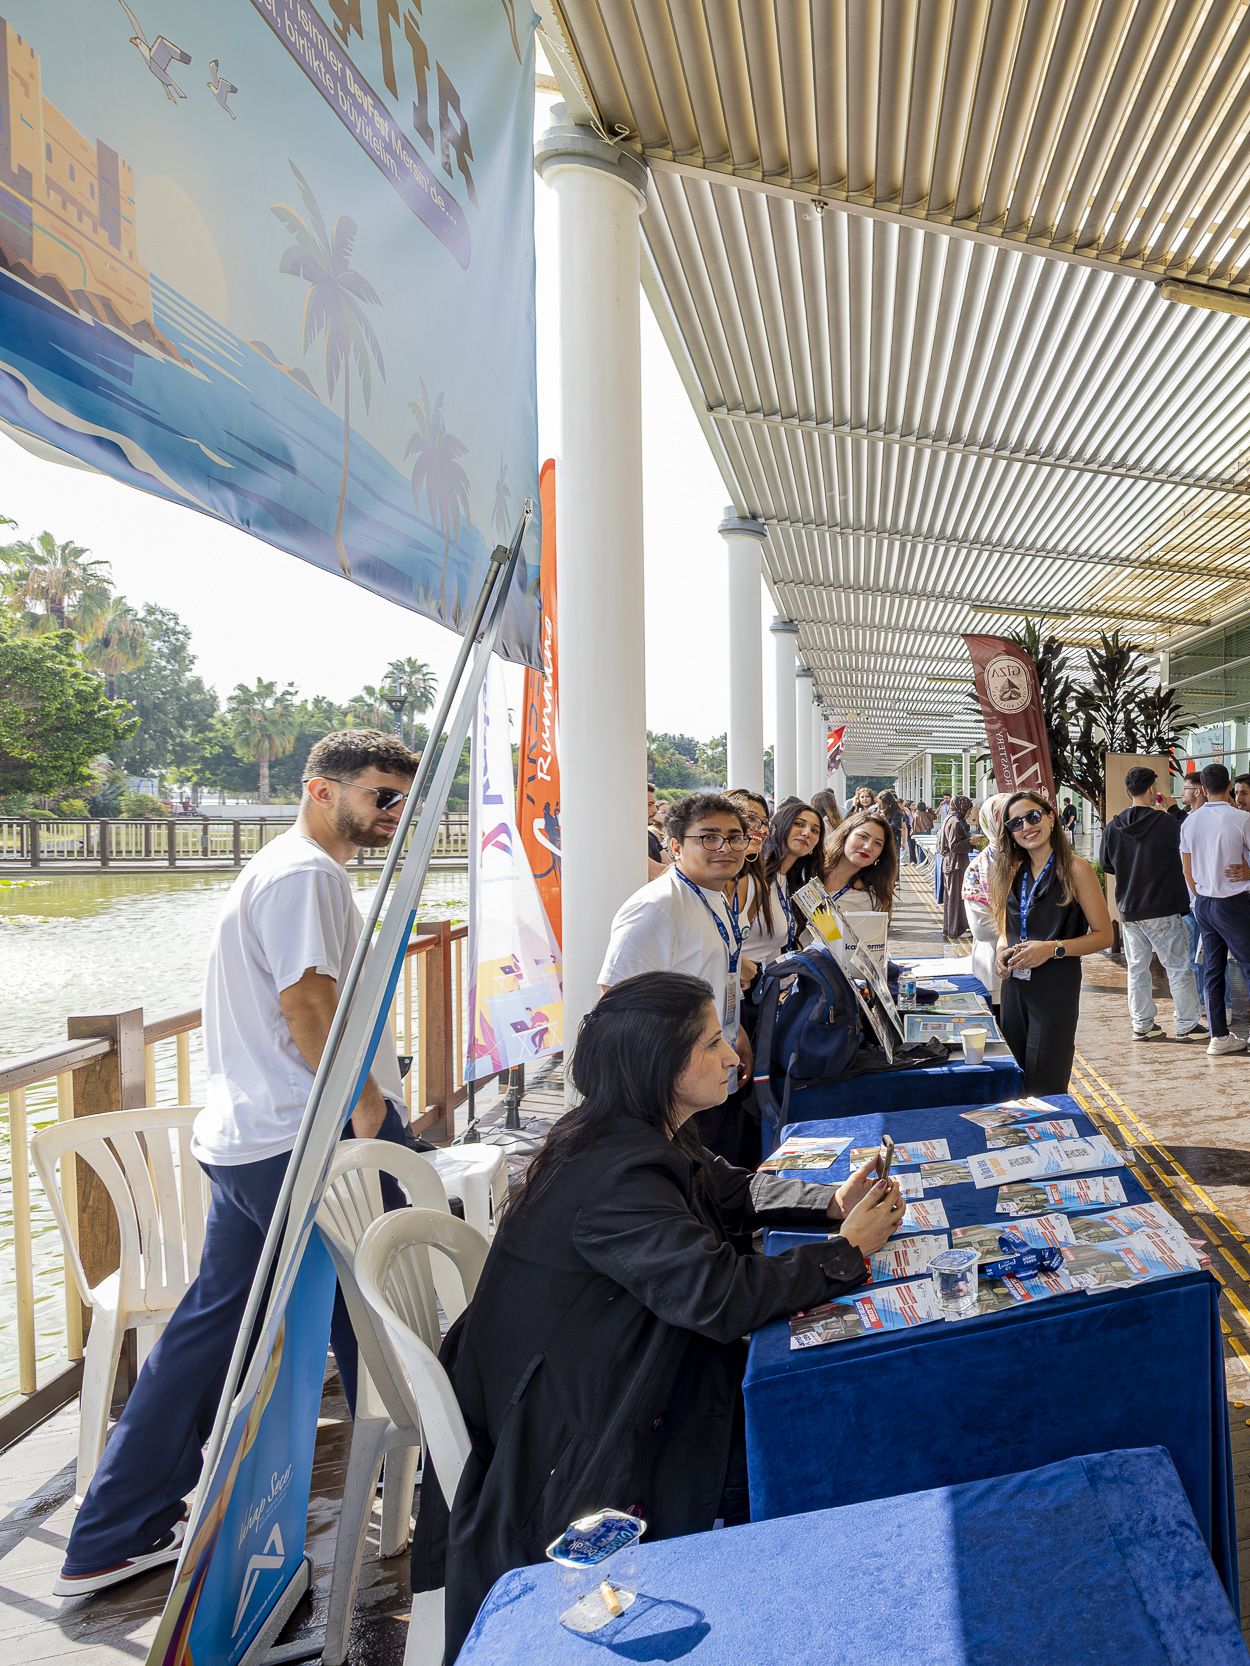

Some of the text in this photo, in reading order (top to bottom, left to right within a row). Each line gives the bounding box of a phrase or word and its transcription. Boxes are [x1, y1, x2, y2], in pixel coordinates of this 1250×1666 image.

[284, 10, 335, 96] birlikte
[337, 86, 402, 181] büyütelim.
[346, 66, 389, 144] DevFest
